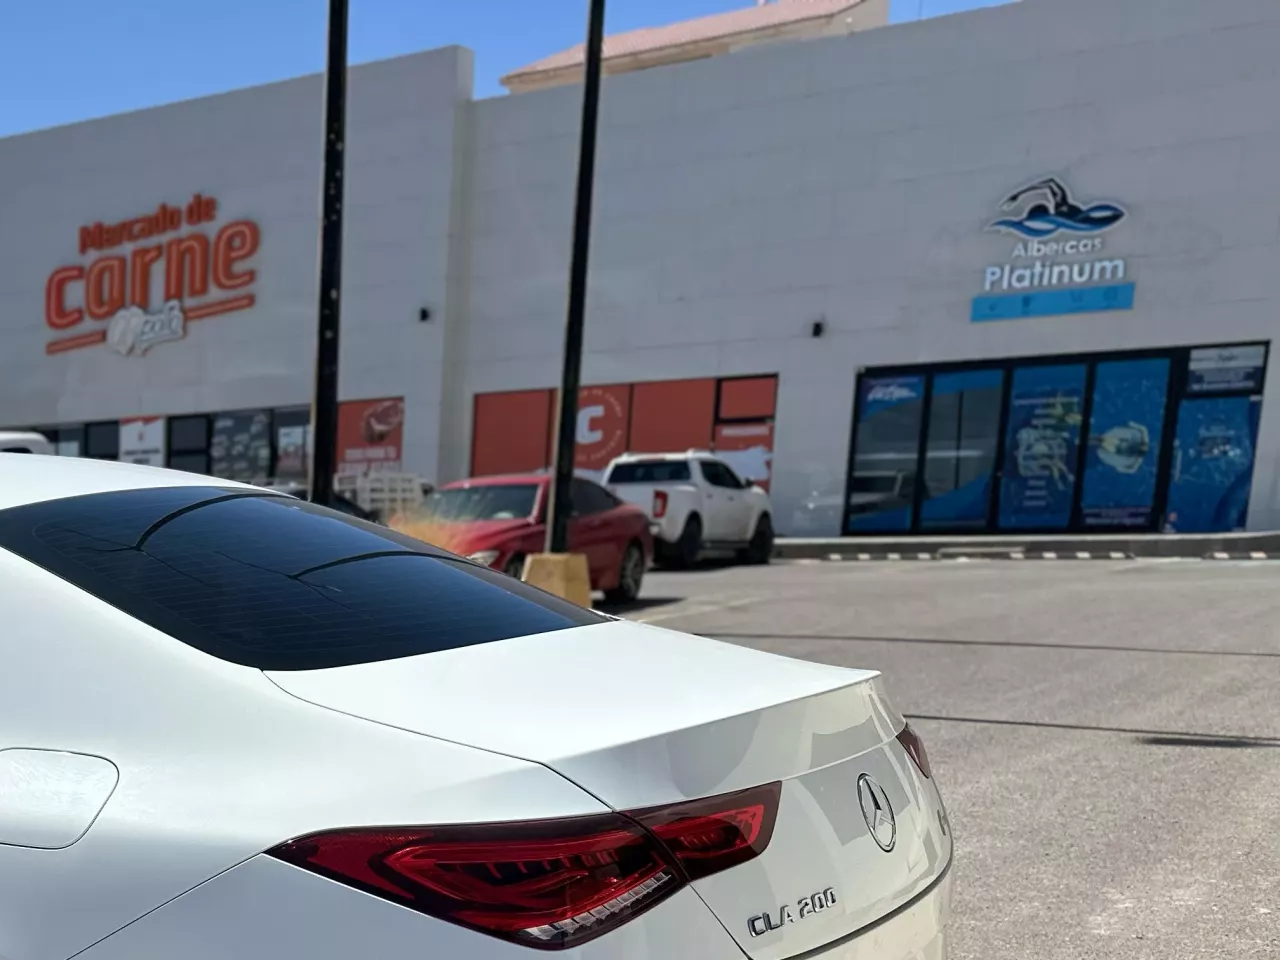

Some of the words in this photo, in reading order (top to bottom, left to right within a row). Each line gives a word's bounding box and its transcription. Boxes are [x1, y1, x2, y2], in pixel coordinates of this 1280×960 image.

[186, 193, 216, 226] de
[1011, 237, 1102, 258] Albercas
[984, 258, 1125, 291] Platinum
[747, 905, 795, 937] CLA
[798, 887, 837, 919] 200
